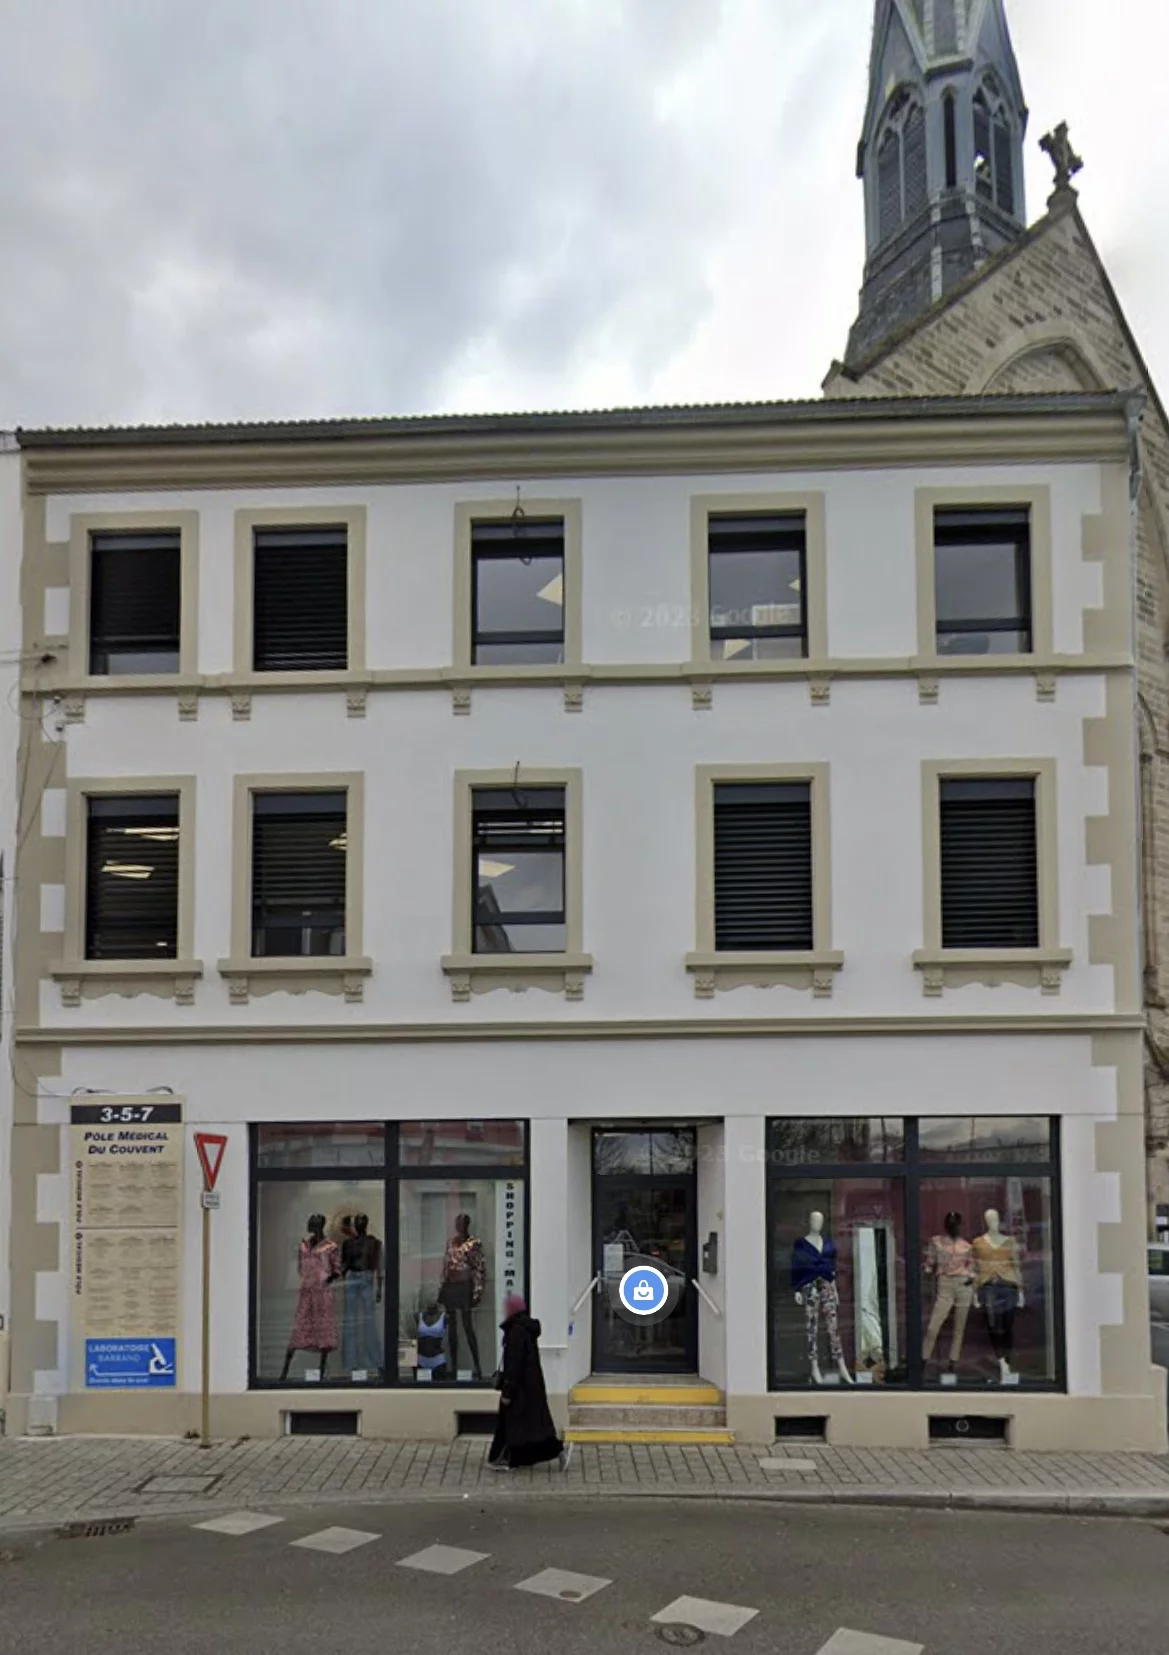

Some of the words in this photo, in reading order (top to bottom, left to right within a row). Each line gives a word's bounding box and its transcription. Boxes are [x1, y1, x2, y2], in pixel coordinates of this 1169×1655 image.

[99, 1106, 155, 1122] 3-5-7
[88, 1145, 106, 1154] DU
[109, 1144, 165, 1154] COUVENT
